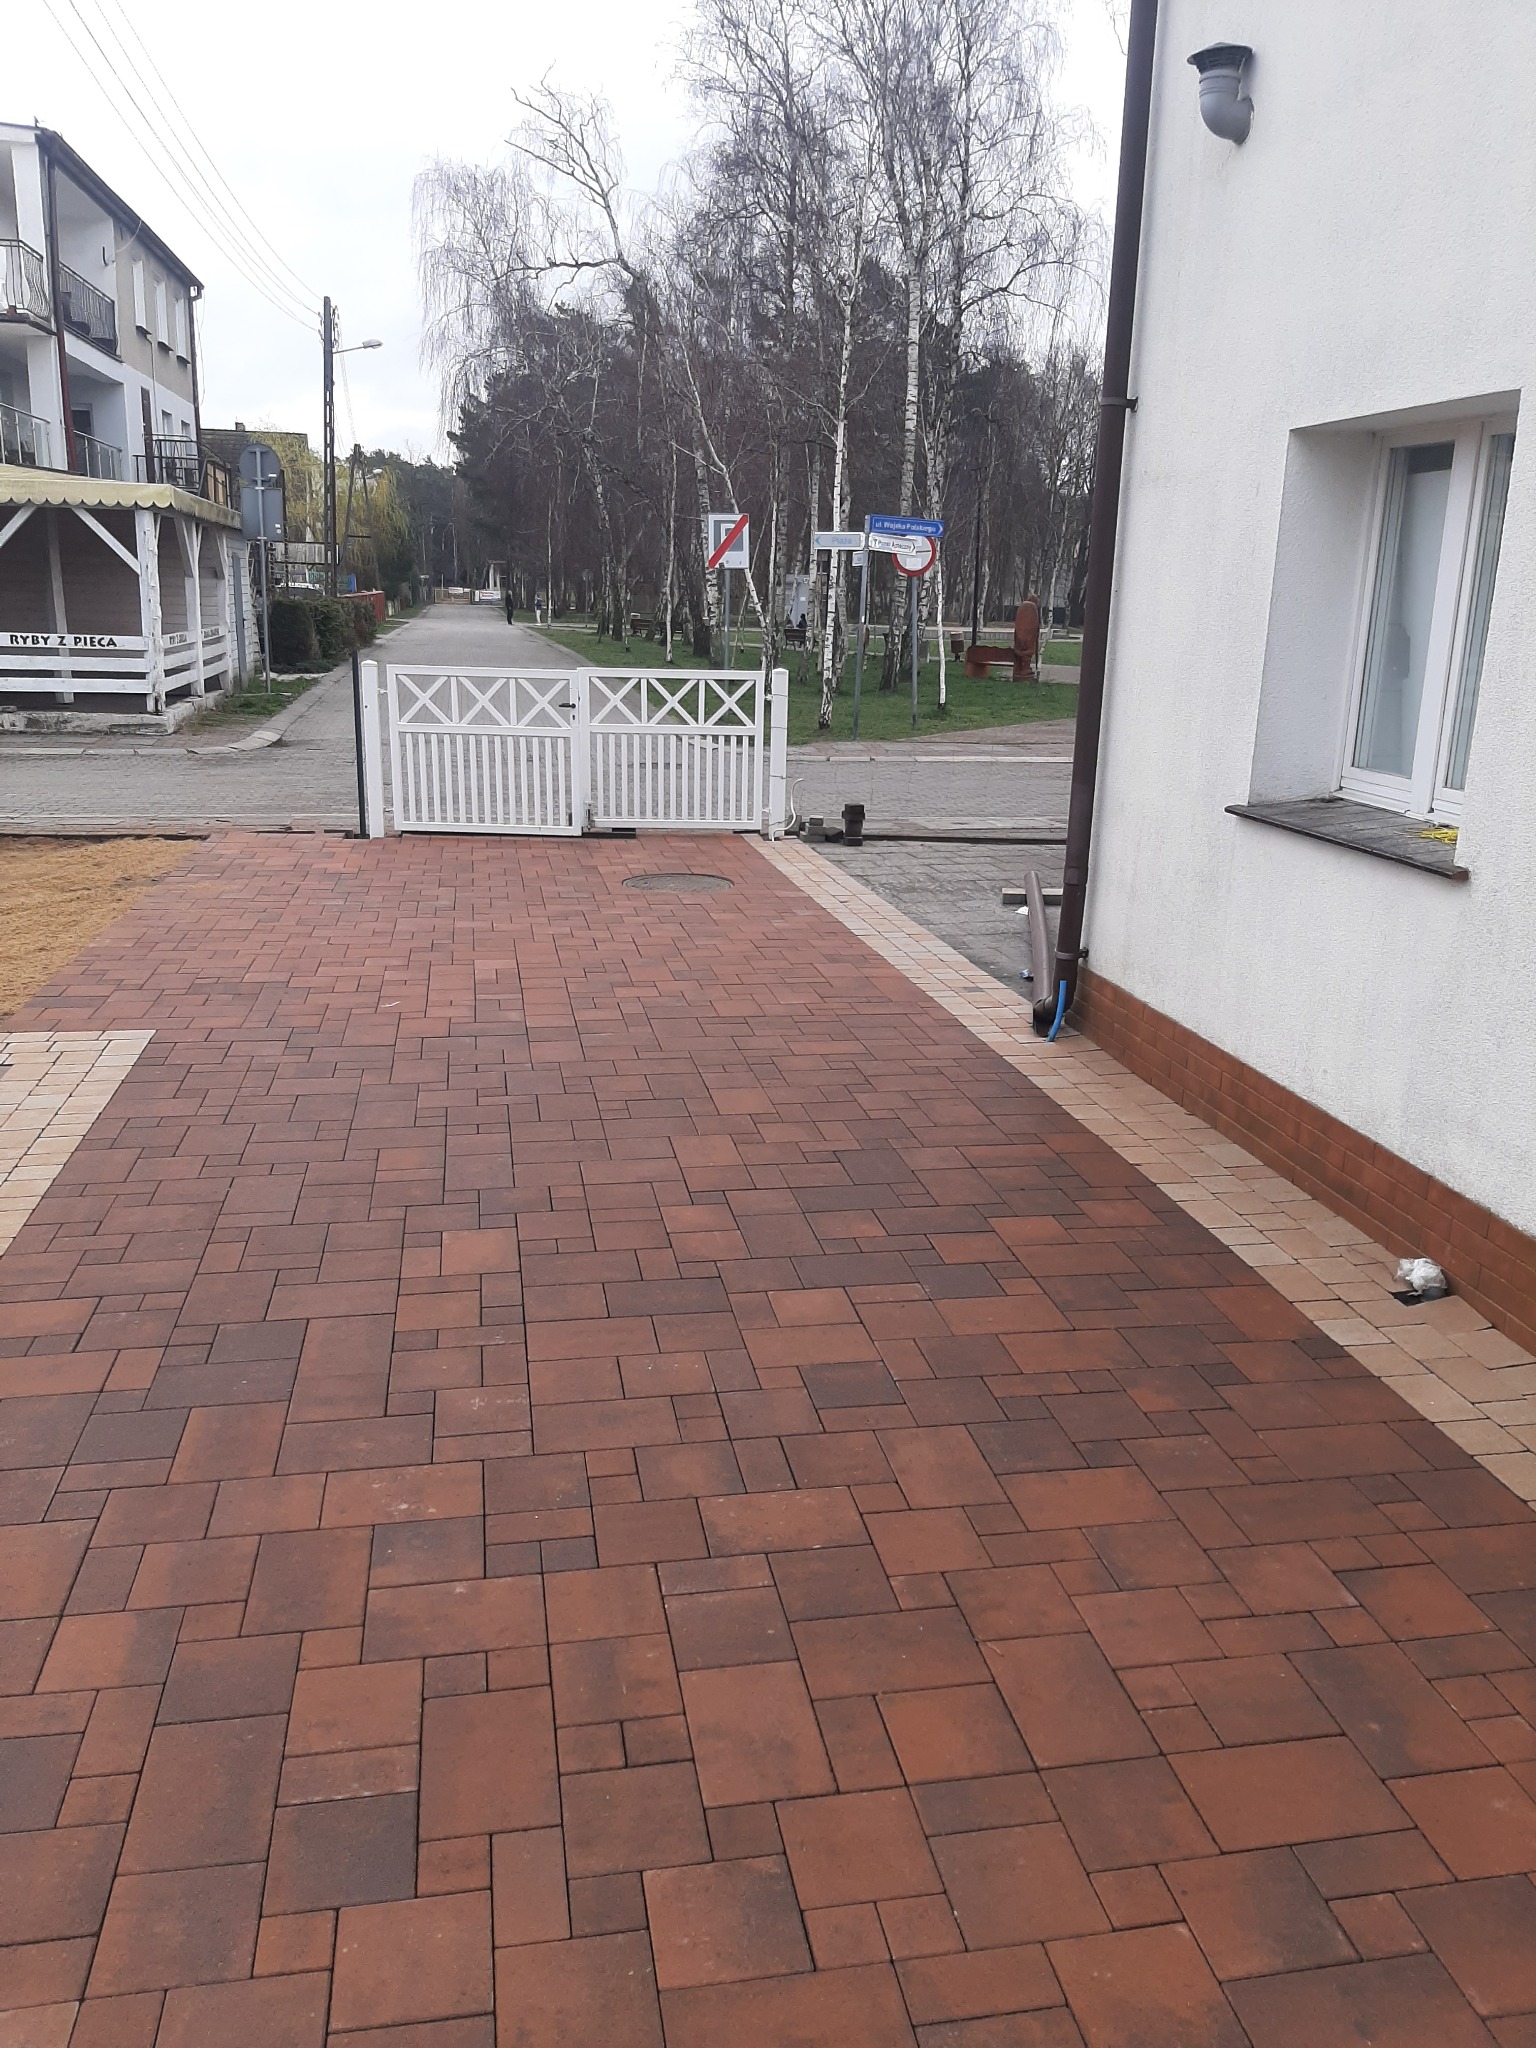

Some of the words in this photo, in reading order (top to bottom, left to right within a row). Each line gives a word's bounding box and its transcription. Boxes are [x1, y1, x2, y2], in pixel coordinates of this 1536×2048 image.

[883, 522, 905, 530] Wojska
[906, 523, 936, 533] Polskiego
[10, 634, 50, 646] RYBY
[58, 636, 66, 646] Z
[74, 636, 118, 647] PIECA
